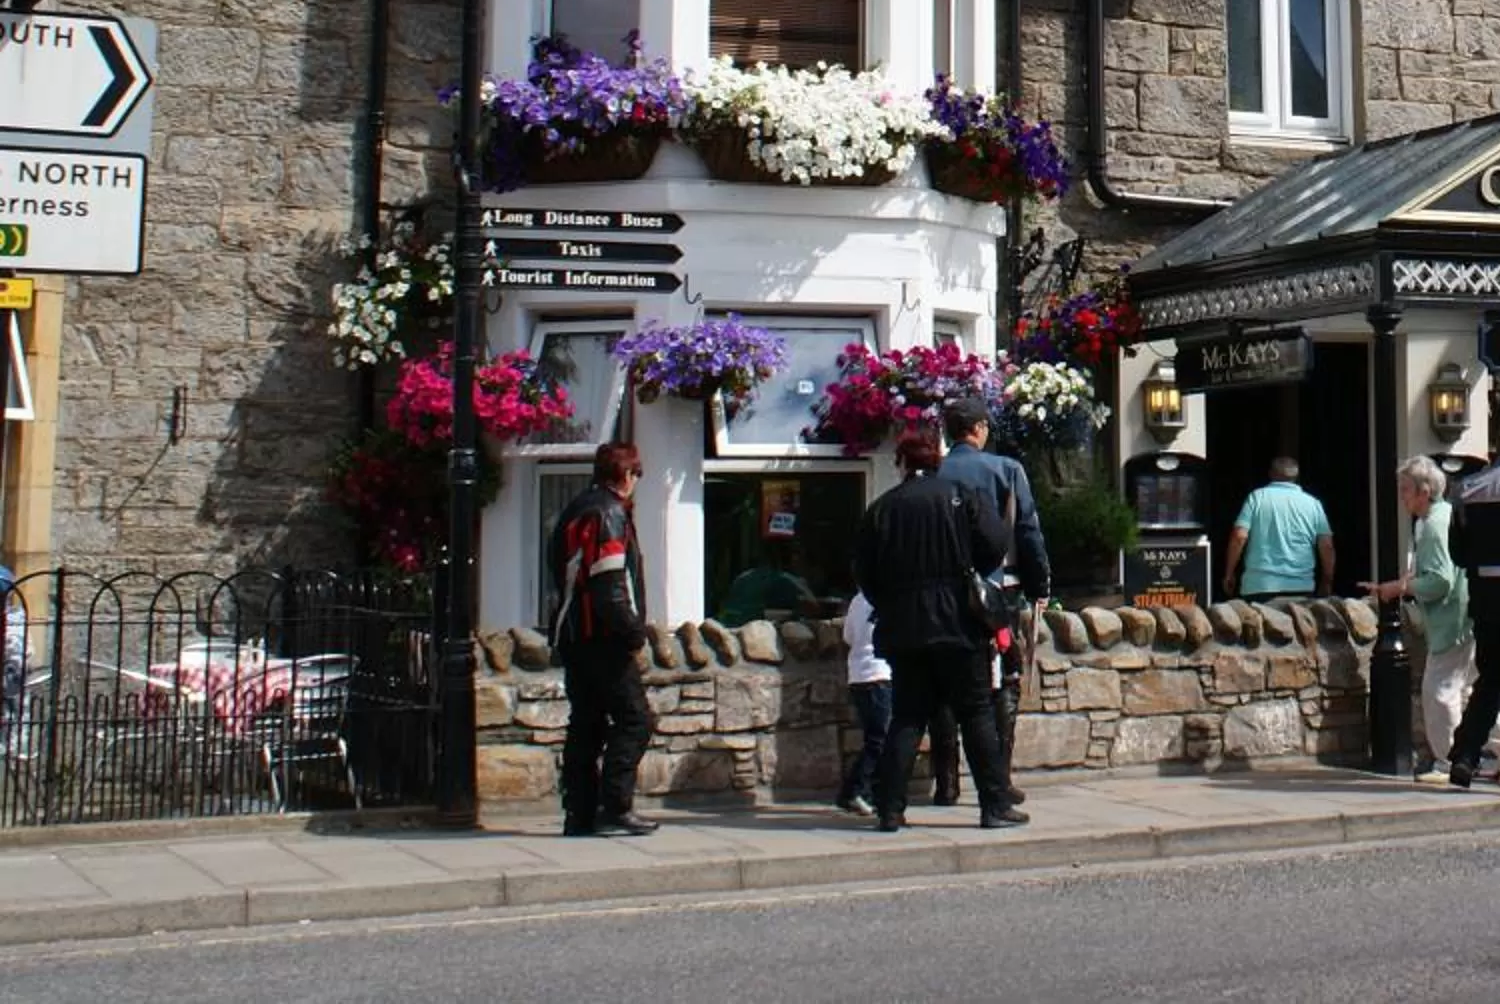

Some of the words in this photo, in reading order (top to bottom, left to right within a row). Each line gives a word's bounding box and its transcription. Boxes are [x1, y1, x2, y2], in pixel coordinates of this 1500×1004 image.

[18, 161, 132, 188] NORTH
[494, 209, 534, 227] Long
[544, 211, 611, 226] Distance
[621, 213, 664, 227] Buses
[559, 242, 602, 257] Taxis
[498, 270, 554, 284] Tourist
[565, 272, 656, 287] Information
[1201, 340, 1280, 371] McKAYS
